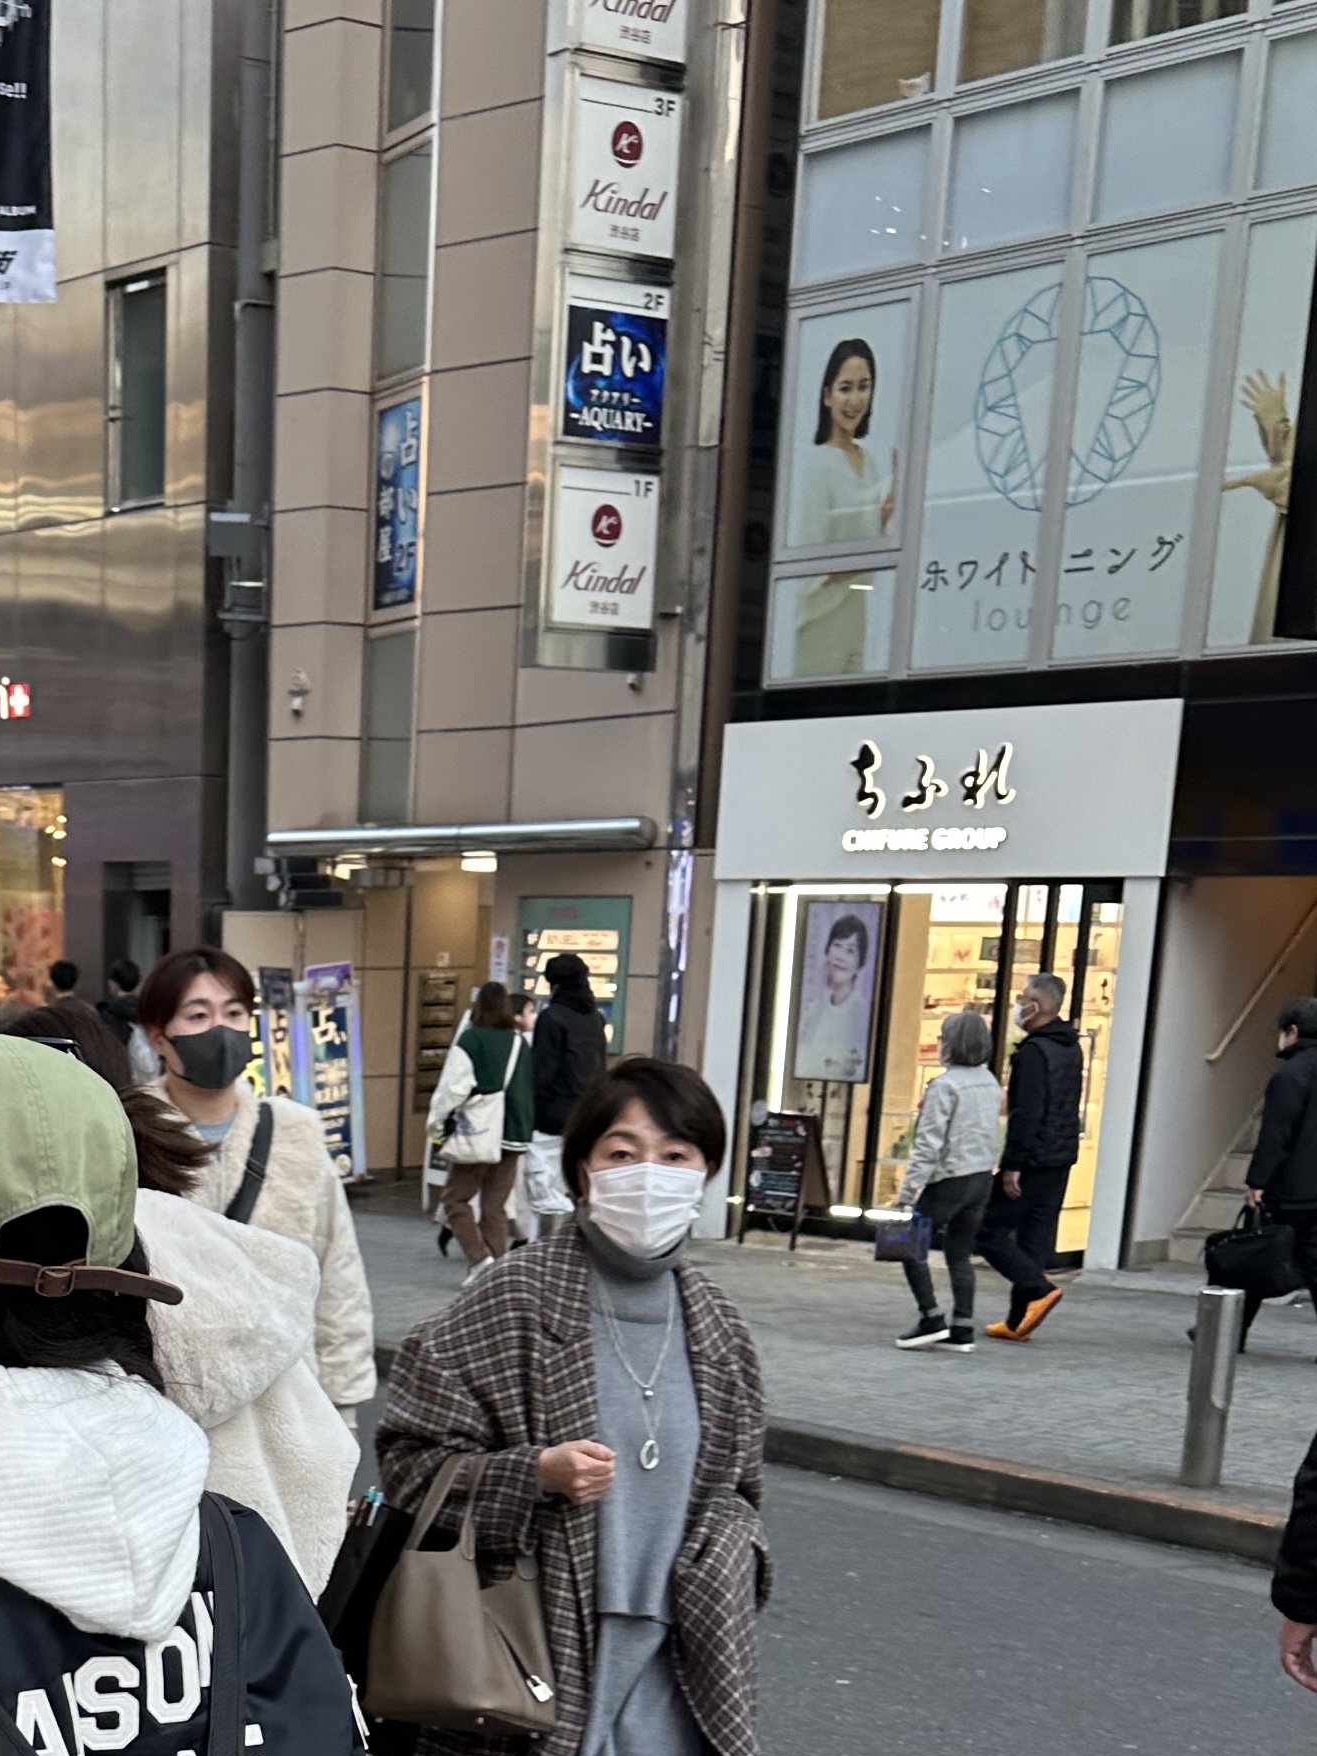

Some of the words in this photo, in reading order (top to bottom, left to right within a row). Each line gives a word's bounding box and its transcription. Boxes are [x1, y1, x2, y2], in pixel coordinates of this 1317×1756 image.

[653, 97, 676, 117] 3F
[580, 179, 669, 221] Kindal
[643, 292, 666, 310] 2F
[580, 321, 653, 378] 占い
[634, 480, 654, 498] 1F
[562, 560, 647, 596] Kindal
[920, 533, 1184, 592] ホワイトニング
[972, 597, 1132, 633] lounge
[849, 739, 1017, 820] ちふれ
[842, 828, 930, 852] CHIFURE
[931, 826, 1008, 851] GROUP
